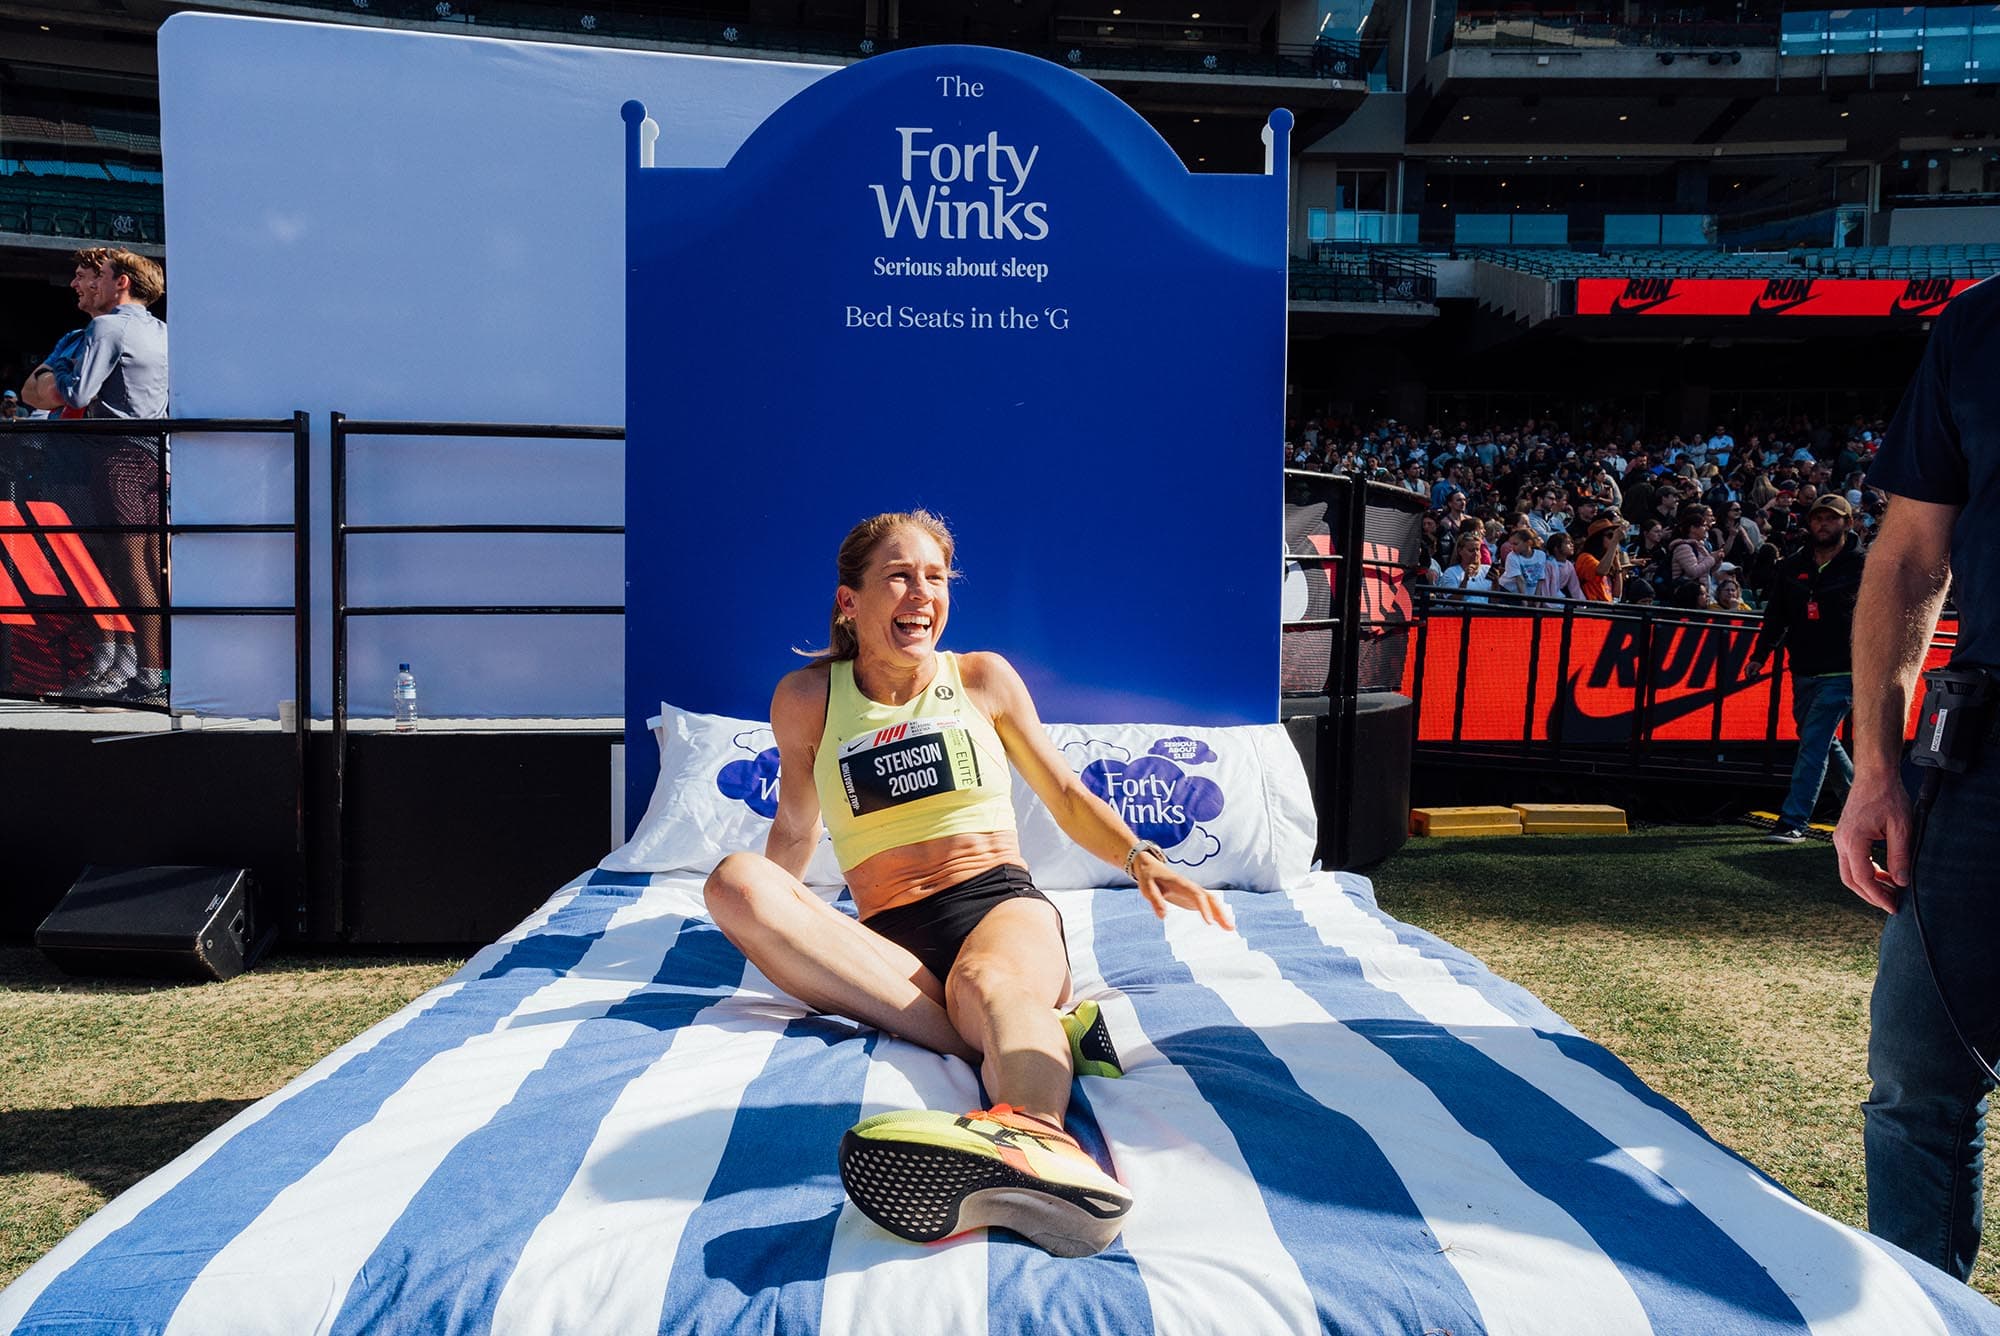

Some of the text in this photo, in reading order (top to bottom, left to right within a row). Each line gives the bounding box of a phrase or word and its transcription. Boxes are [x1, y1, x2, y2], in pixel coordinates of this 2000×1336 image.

[936, 75, 985, 98] The
[895, 127, 1040, 196] Forty
[868, 184, 1050, 241] Winks
[873, 256, 1049, 283] Serious about sleep
[1622, 278, 1675, 300] RUN
[1762, 279, 1815, 301] RUN
[1902, 279, 1956, 301] RUN
[846, 305, 893, 328] Bed
[898, 306, 965, 329] Seats
[971, 307, 993, 329] in
[999, 306, 1040, 329] the
[1586, 616, 1762, 690] RUN
[873, 742, 943, 776] STENSON
[955, 751, 974, 786] ELITE
[888, 767, 939, 797] 20000
[1103, 773, 1177, 804] Forty
